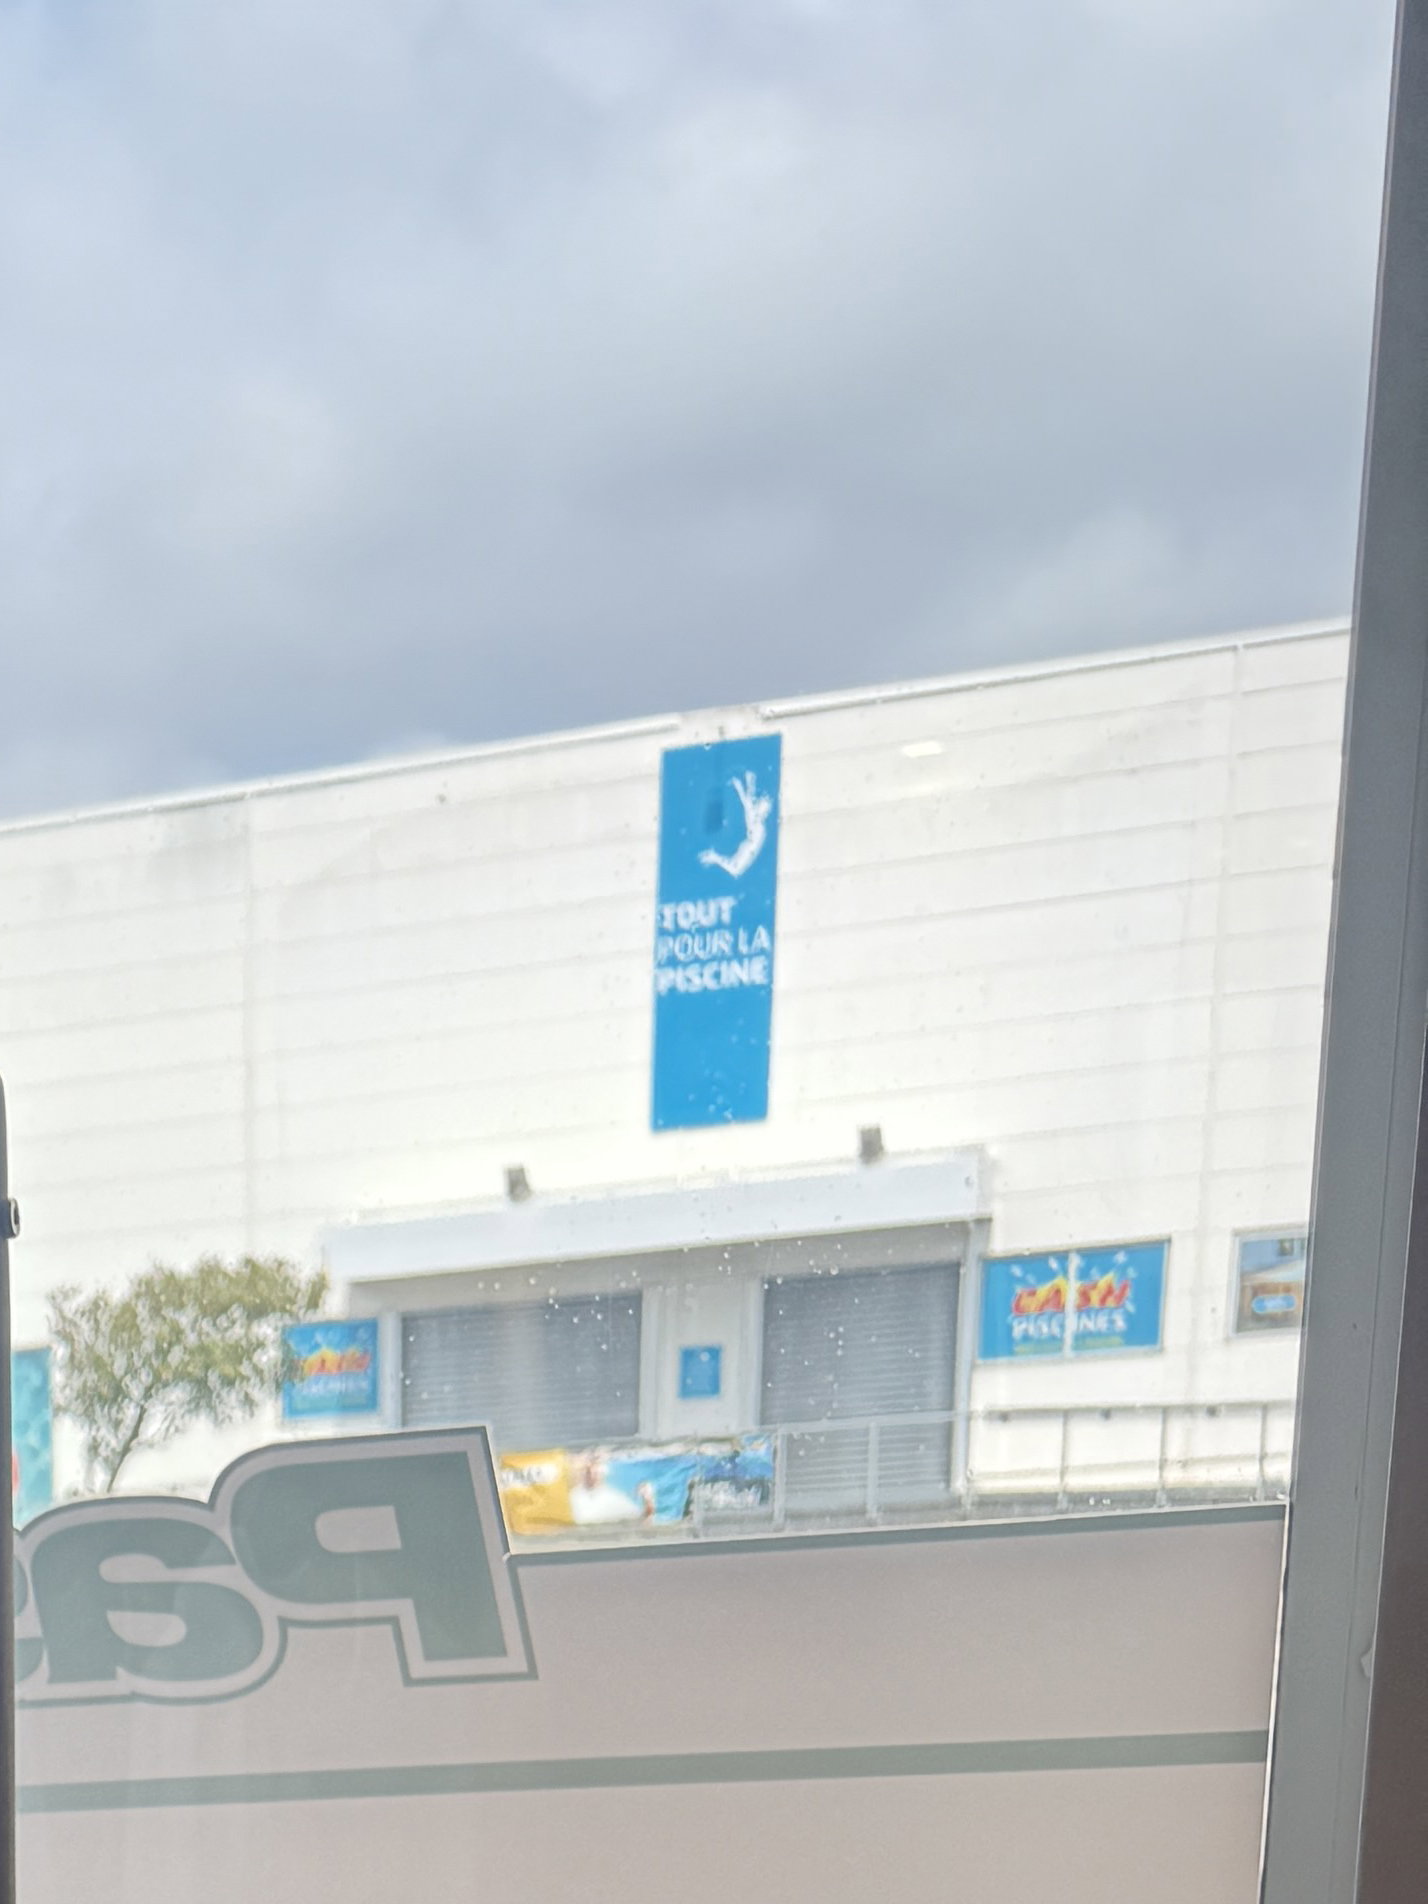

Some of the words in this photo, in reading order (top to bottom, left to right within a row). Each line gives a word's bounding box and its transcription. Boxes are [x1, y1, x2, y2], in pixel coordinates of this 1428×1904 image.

[659, 896, 737, 932] TOUT
[657, 929, 733, 965] POUR
[738, 924, 771, 955] LA
[655, 955, 768, 995] PISCINE
[1012, 1278, 1131, 1317] CASH
[1012, 1308, 1127, 1339] PISCNES
